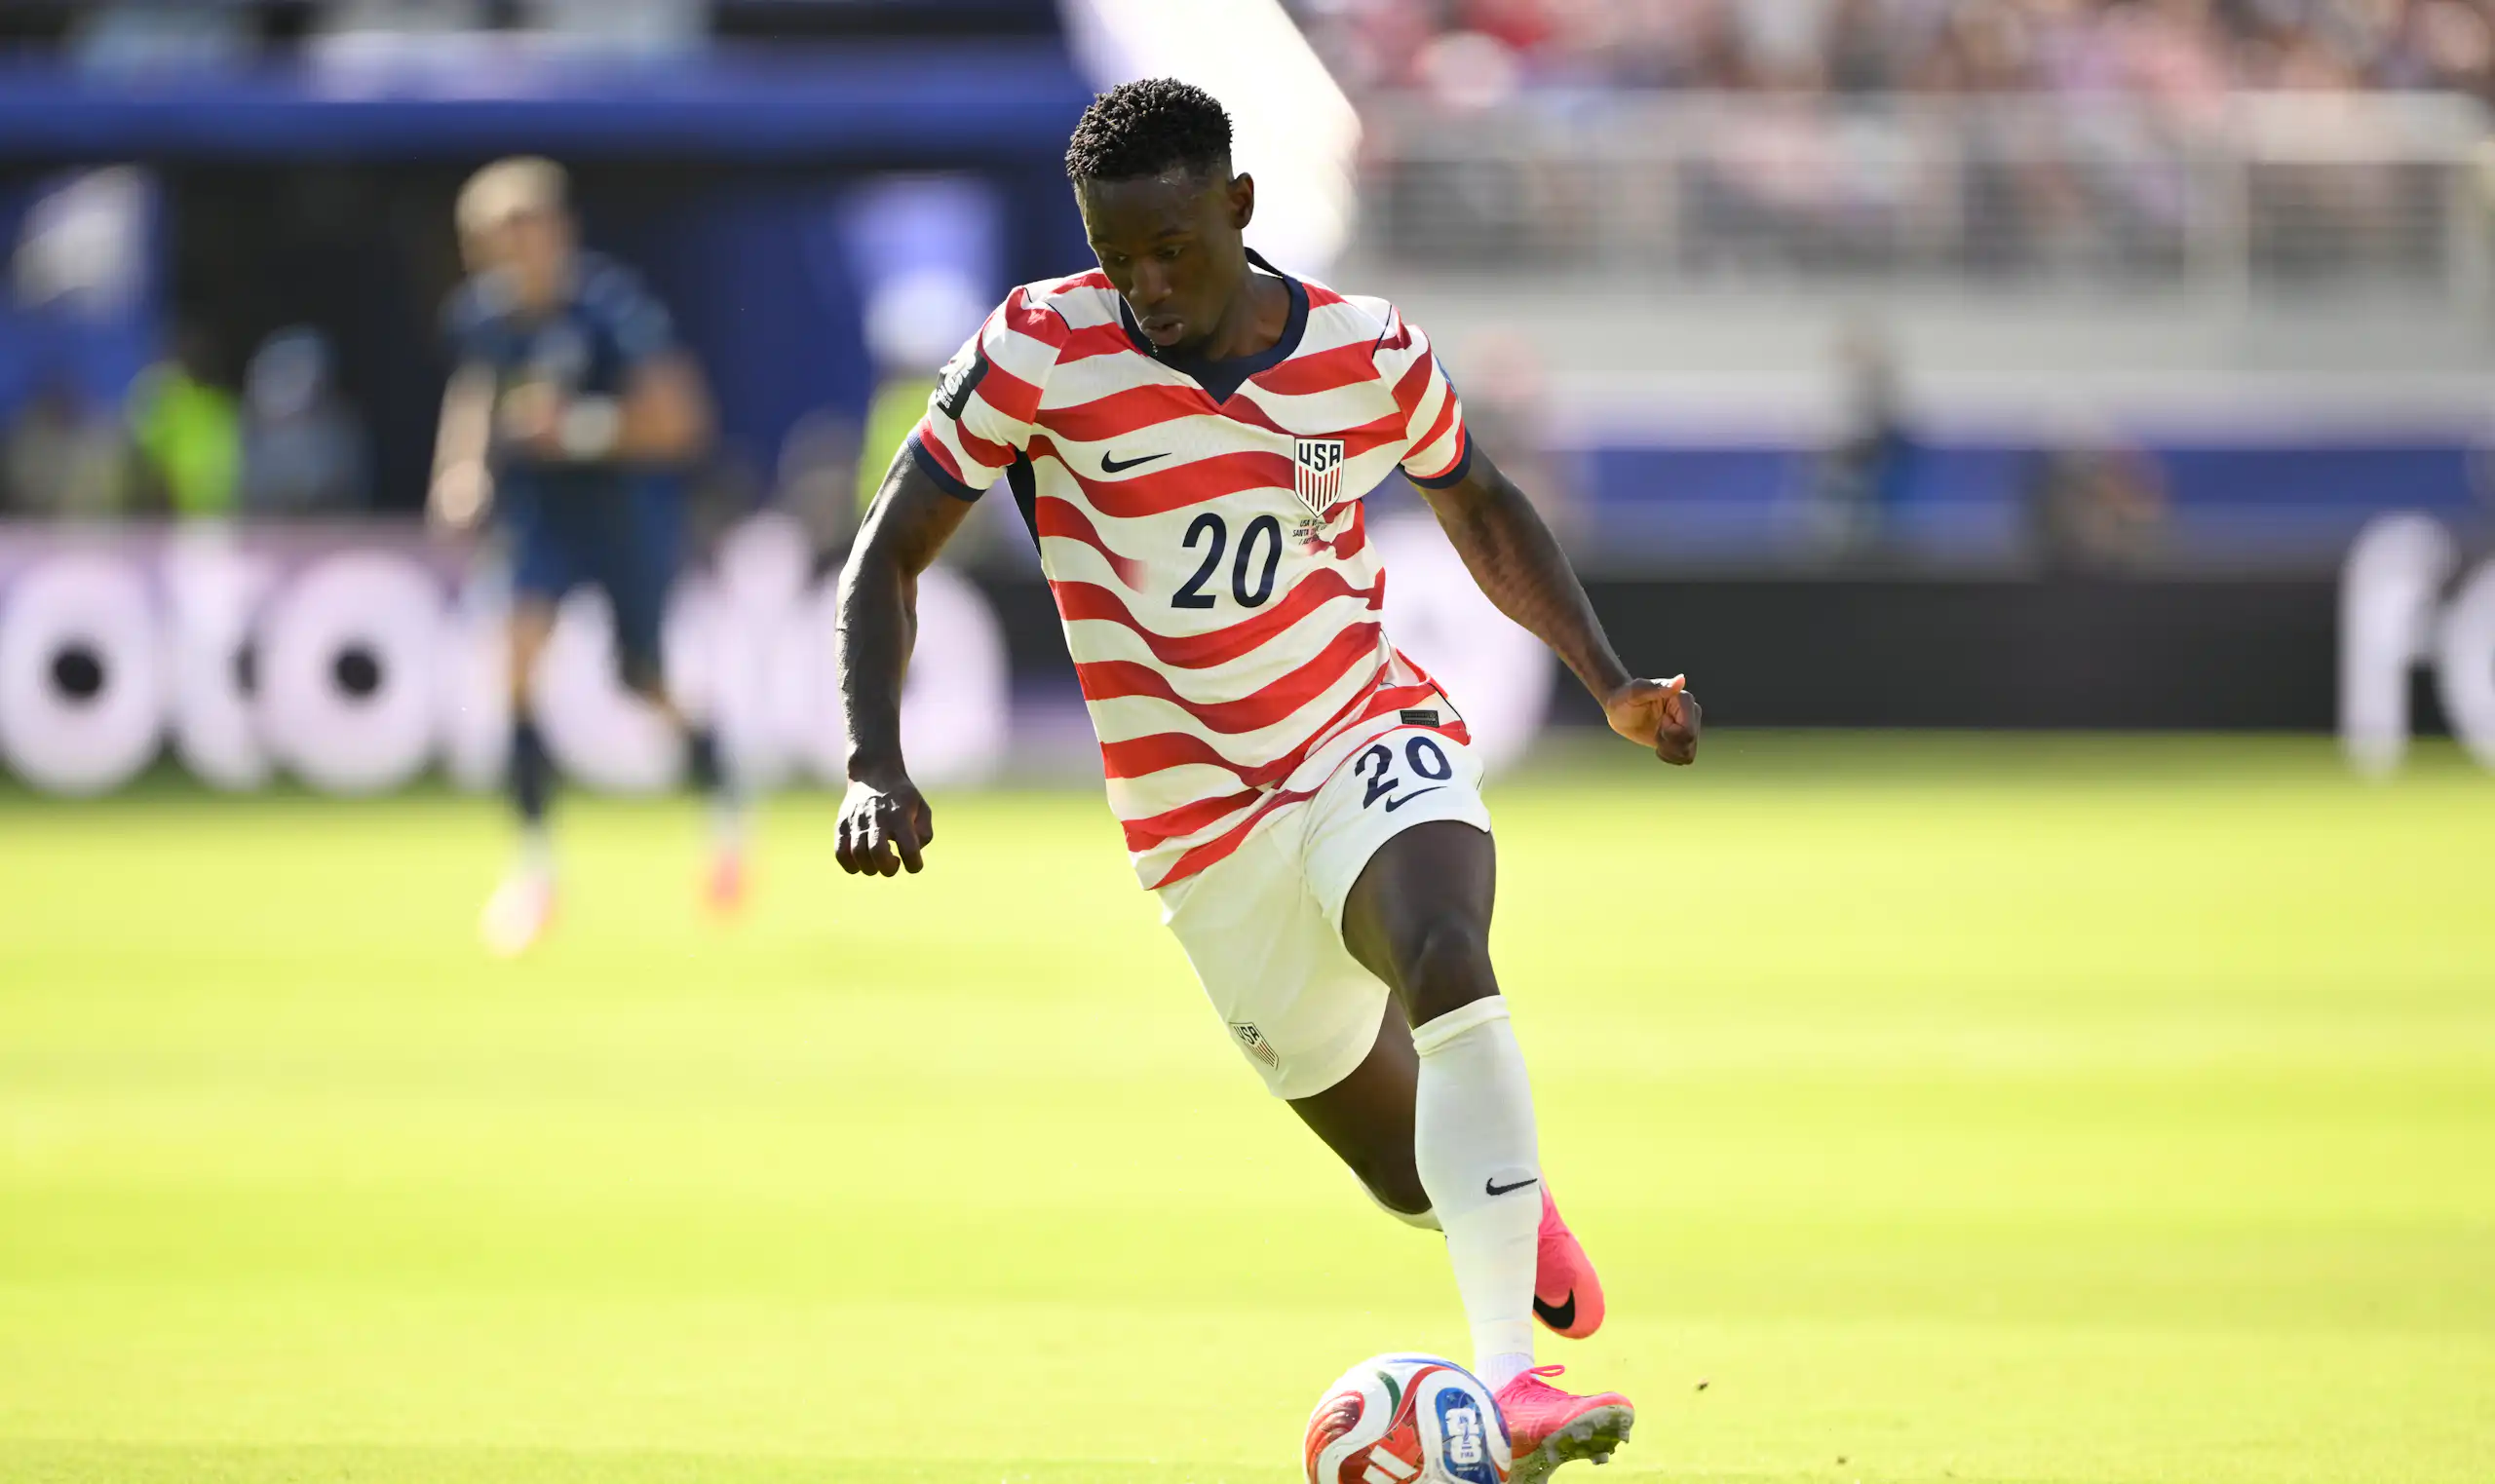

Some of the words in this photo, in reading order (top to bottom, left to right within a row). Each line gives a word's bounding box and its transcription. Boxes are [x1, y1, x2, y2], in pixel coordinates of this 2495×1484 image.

[1298, 442, 1341, 472] USA
[1171, 513, 1283, 609] 20
[1354, 736, 1453, 810] 20
[1233, 1025, 1260, 1046] USA
